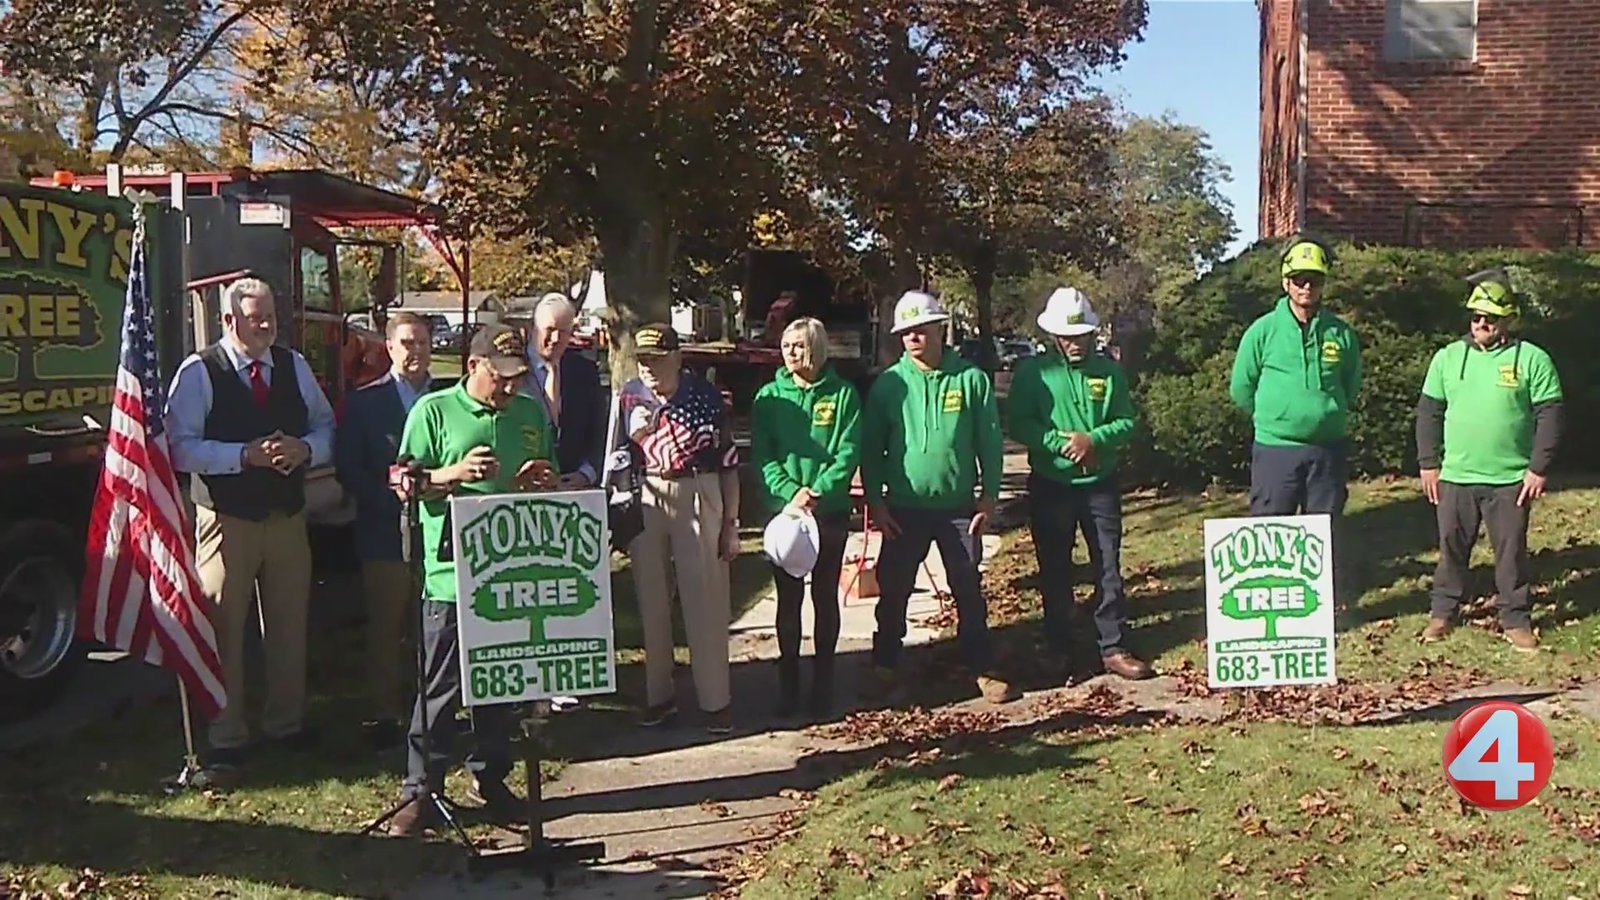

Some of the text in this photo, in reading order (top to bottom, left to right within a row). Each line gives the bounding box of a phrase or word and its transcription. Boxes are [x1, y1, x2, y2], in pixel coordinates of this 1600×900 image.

[0, 294, 80, 337] REE
[461, 500, 602, 575] TONY'S
[1212, 523, 1324, 582] TONY'S
[490, 578, 579, 610] TREE
[1232, 586, 1306, 611] TREE
[476, 640, 600, 660] LANDSCAPING
[1221, 639, 1322, 652] LANDSCAPING
[471, 656, 609, 698] 683-TREE
[1216, 651, 1328, 682] 683-TREE
